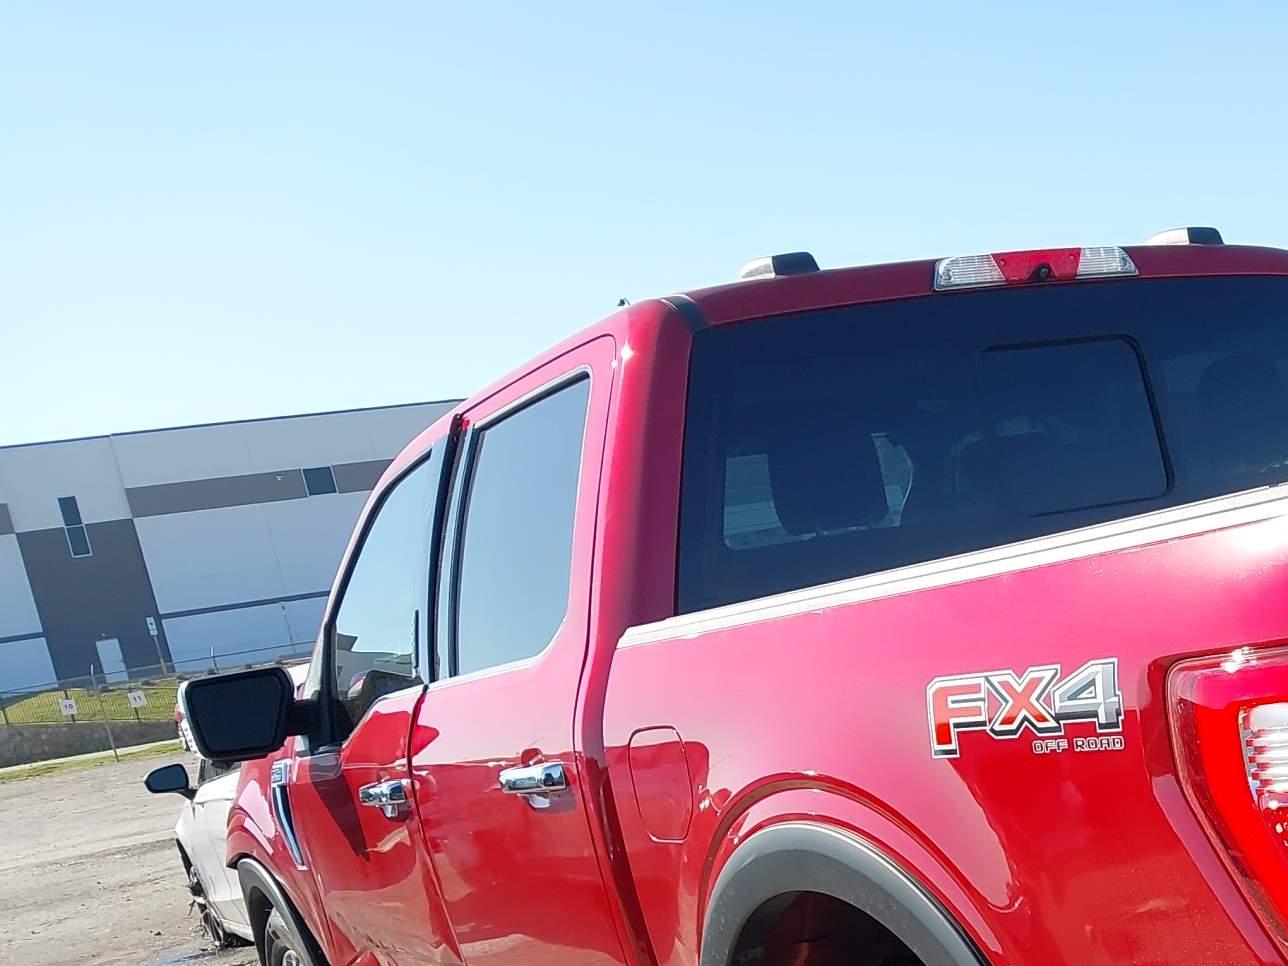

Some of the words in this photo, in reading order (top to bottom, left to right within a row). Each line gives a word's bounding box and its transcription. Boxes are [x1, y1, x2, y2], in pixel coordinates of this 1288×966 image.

[927, 657, 1123, 758] FX4
[1032, 739, 1068, 753] OFF
[1074, 736, 1124, 753] ROAD
